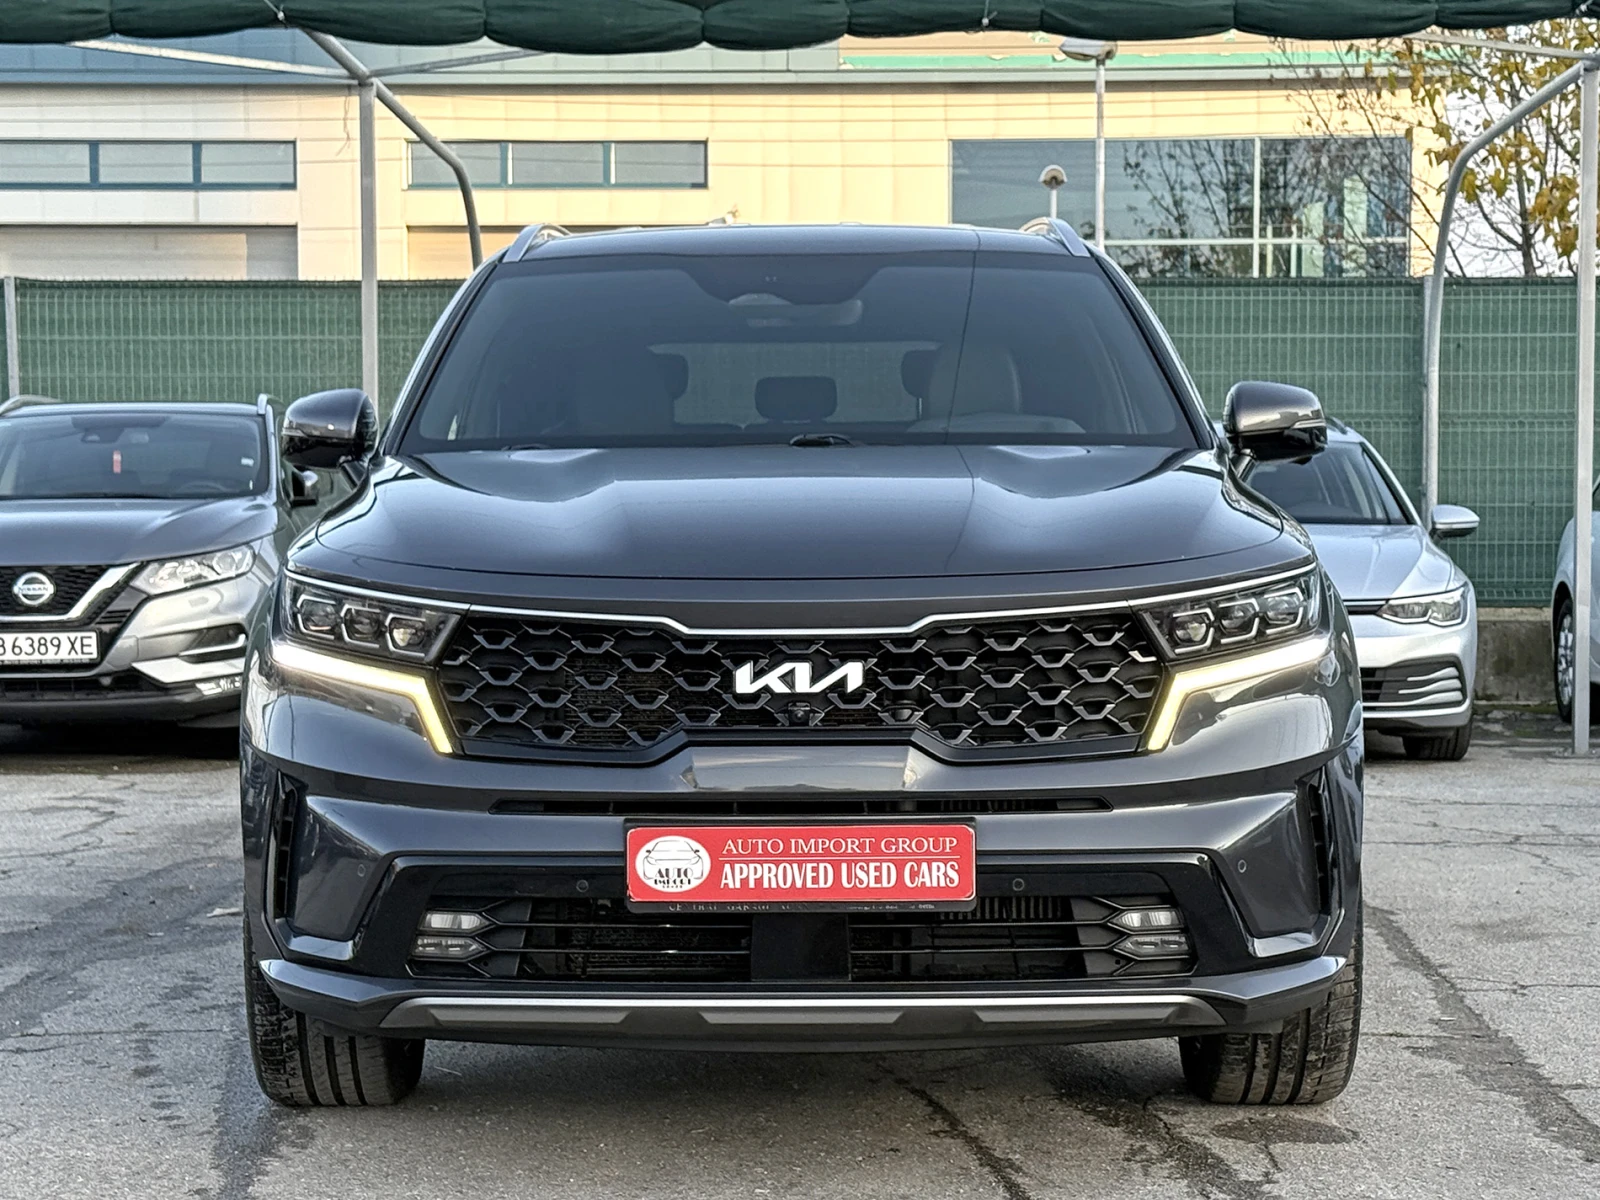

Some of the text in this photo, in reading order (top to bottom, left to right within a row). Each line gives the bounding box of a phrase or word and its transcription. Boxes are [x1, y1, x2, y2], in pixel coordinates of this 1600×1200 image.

[11, 636, 61, 656] 6389
[67, 636, 93, 656] XE
[733, 660, 865, 694] KIA
[722, 836, 958, 855] AUTO IMPORT GROUP
[655, 867, 693, 879] AUTO
[720, 861, 960, 889] APPROVED USED CARS
